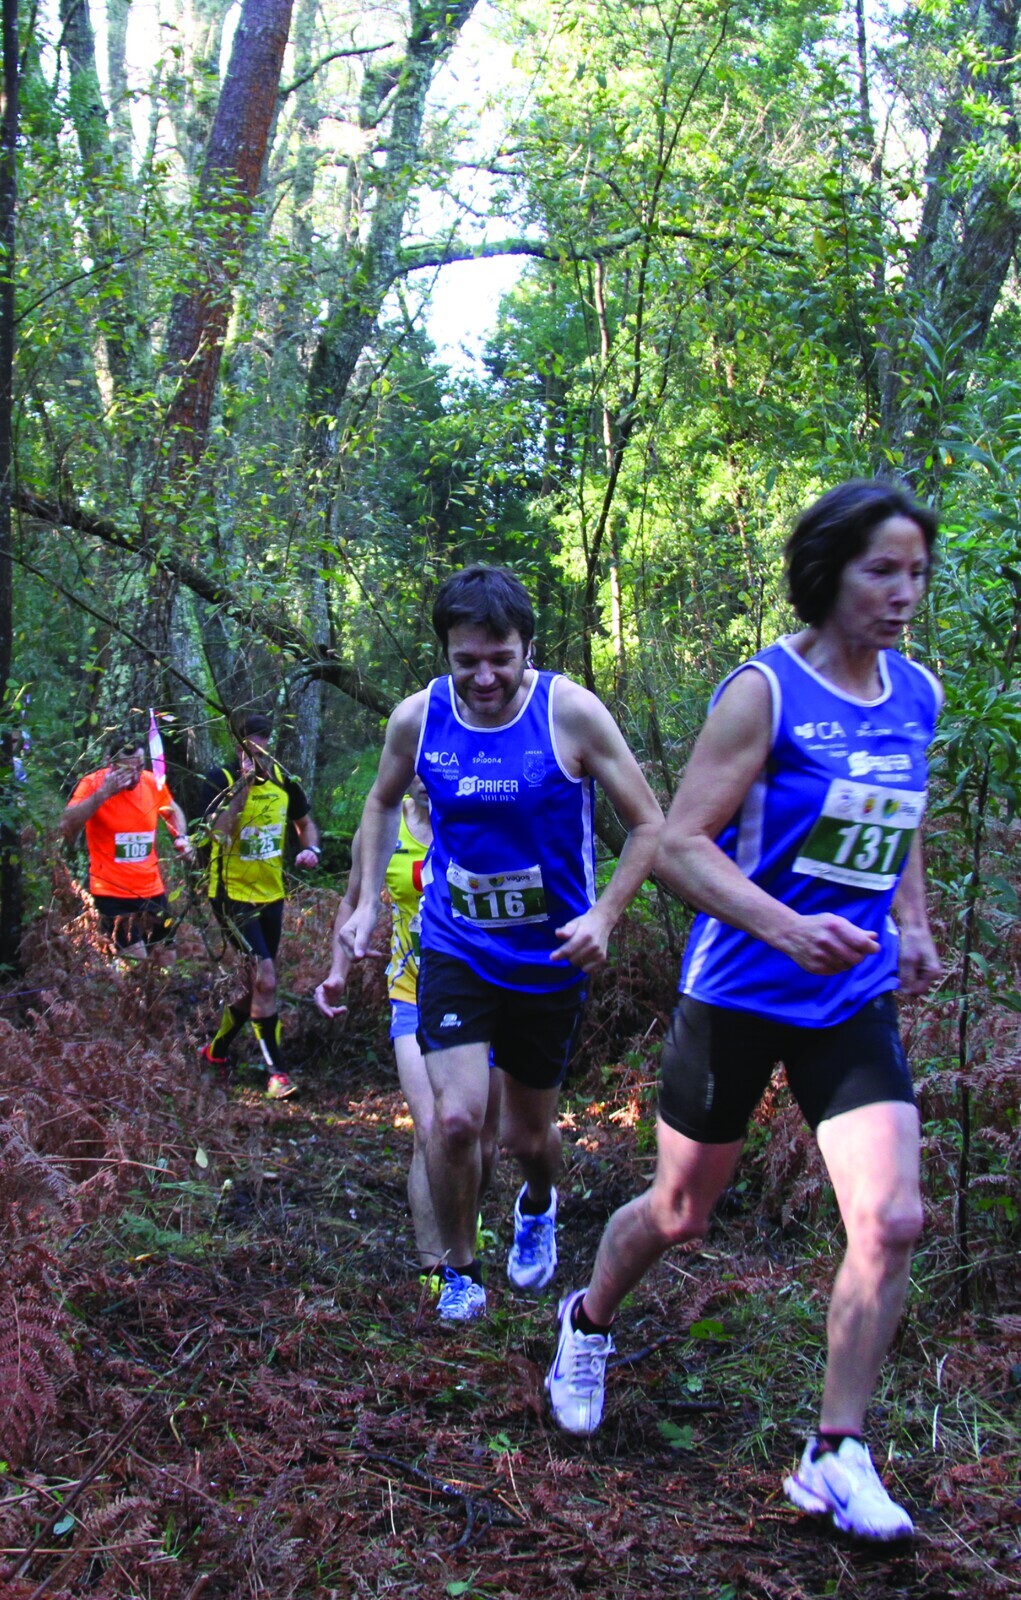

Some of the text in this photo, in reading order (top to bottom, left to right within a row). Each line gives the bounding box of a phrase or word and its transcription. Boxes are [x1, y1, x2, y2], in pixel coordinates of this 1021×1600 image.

[816, 721, 847, 740] CA
[440, 751, 460, 766] CA
[477, 779, 519, 793] PRIFER
[123, 842, 148, 858] 108
[833, 824, 903, 873] 131
[462, 891, 526, 918] 116
